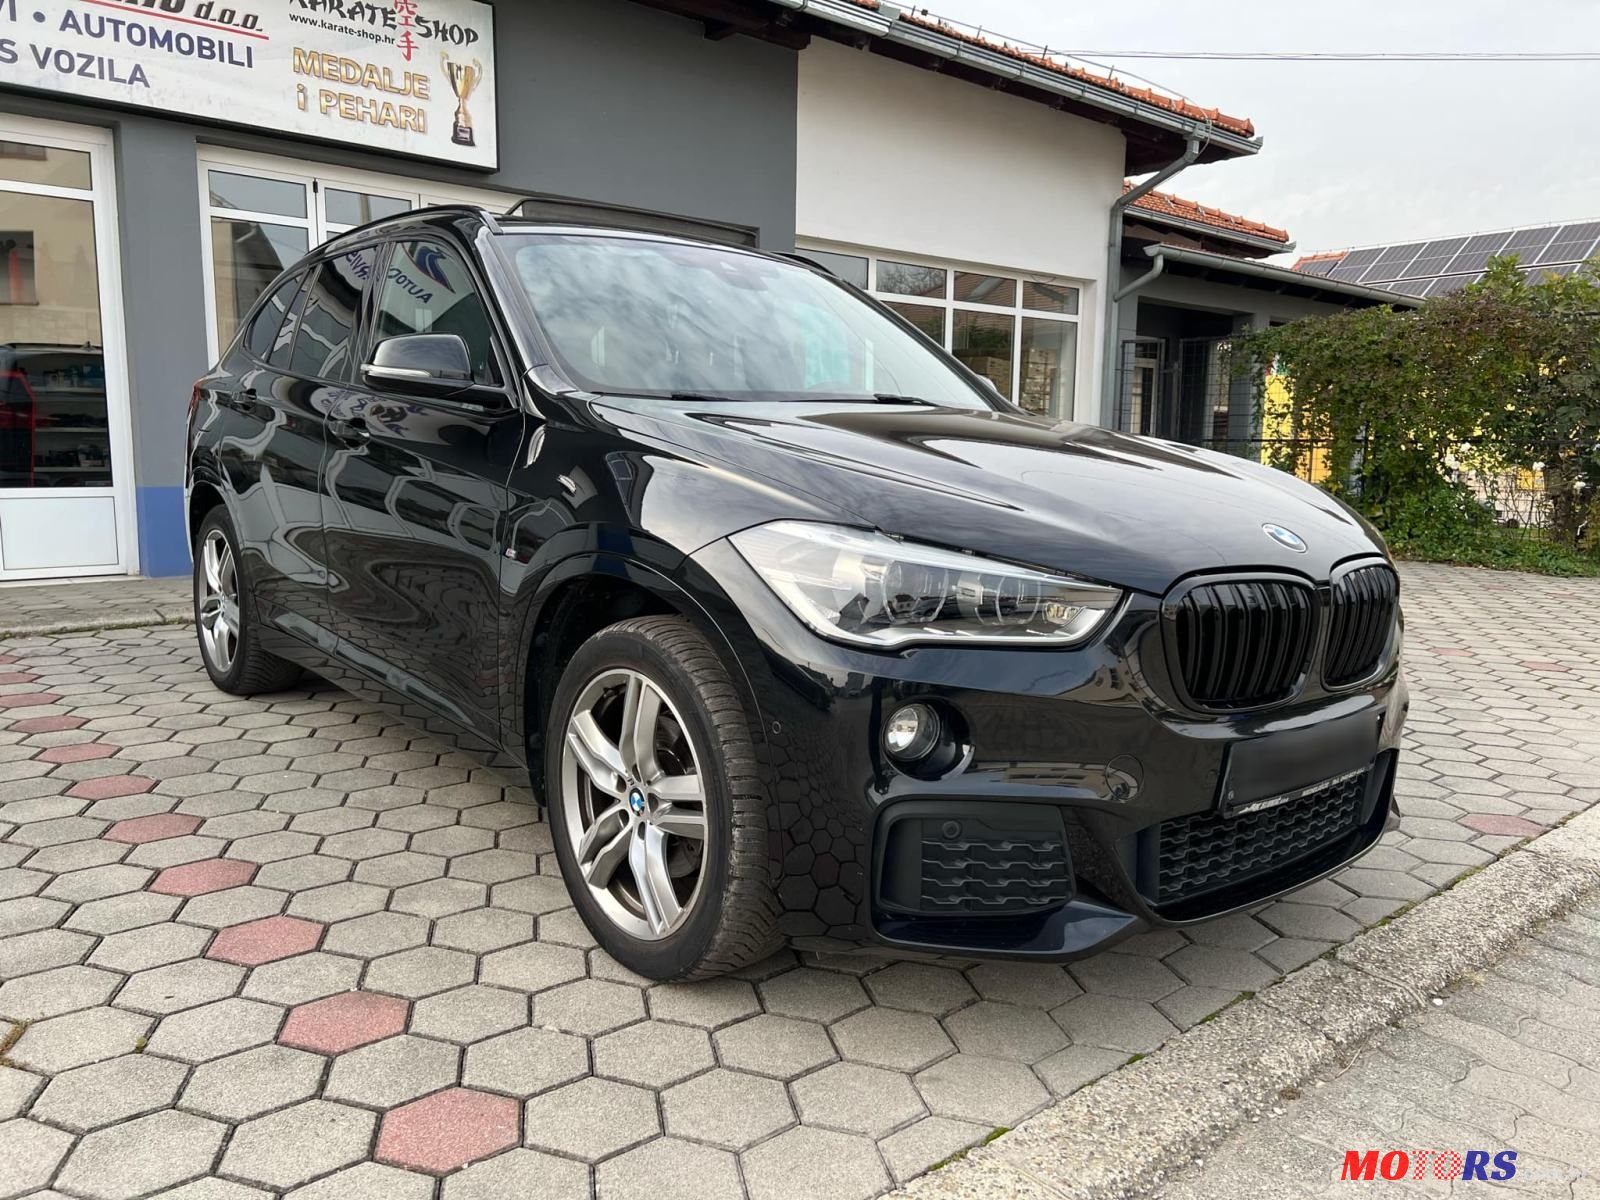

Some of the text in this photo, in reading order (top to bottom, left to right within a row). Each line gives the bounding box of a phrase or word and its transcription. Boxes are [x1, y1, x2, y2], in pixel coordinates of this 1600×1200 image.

[59, 9, 254, 69] AUTOMOBILI
[193, 1, 263, 32] d.o.o.
[289, 13, 396, 45] www.karate-shop.hr
[415, 16, 478, 47] SHOP
[29, 43, 151, 88] VOZILA
[292, 47, 430, 100] MEDALJE
[296, 83, 427, 133] i PEHARI
